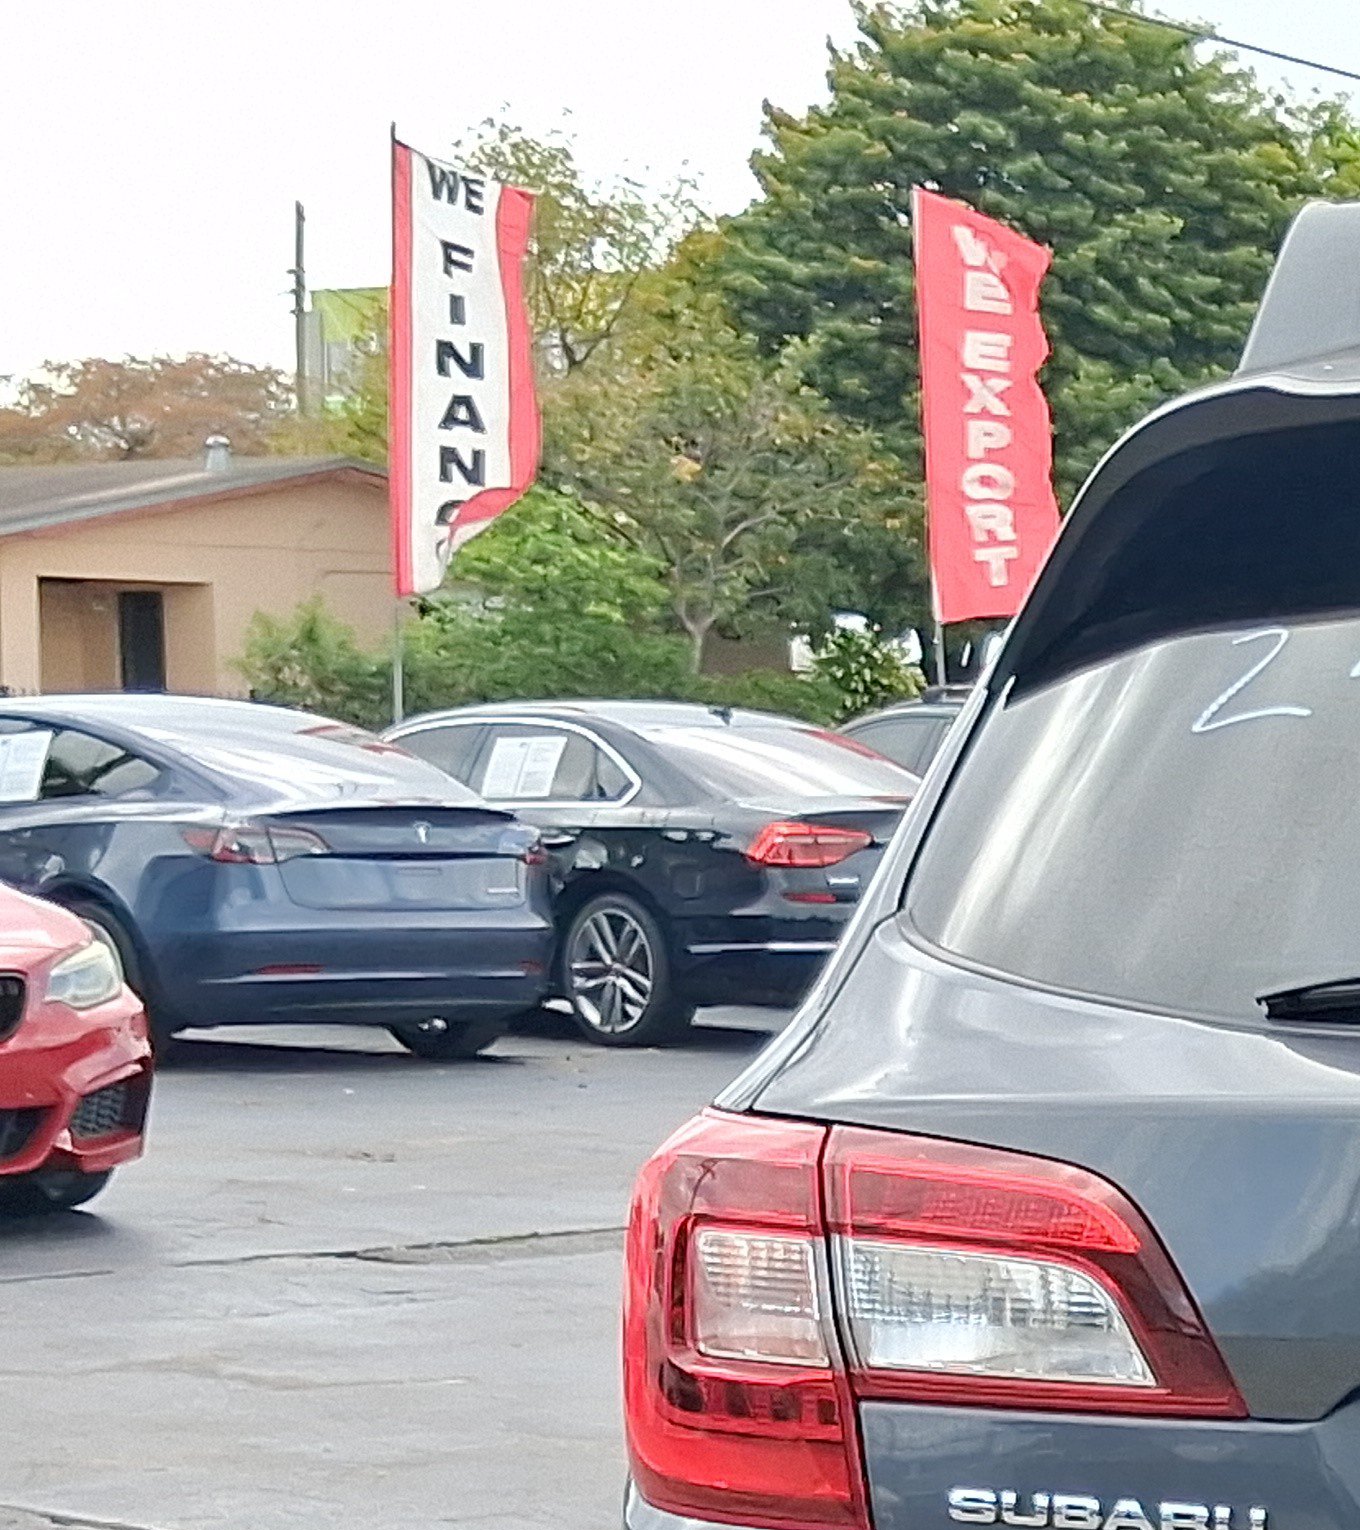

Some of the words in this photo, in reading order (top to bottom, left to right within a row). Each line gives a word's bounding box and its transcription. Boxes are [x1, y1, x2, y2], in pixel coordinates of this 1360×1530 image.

[427, 159, 485, 216] WE
[949, 224, 1013, 315] WE
[959, 330, 1020, 588] EXPORT
